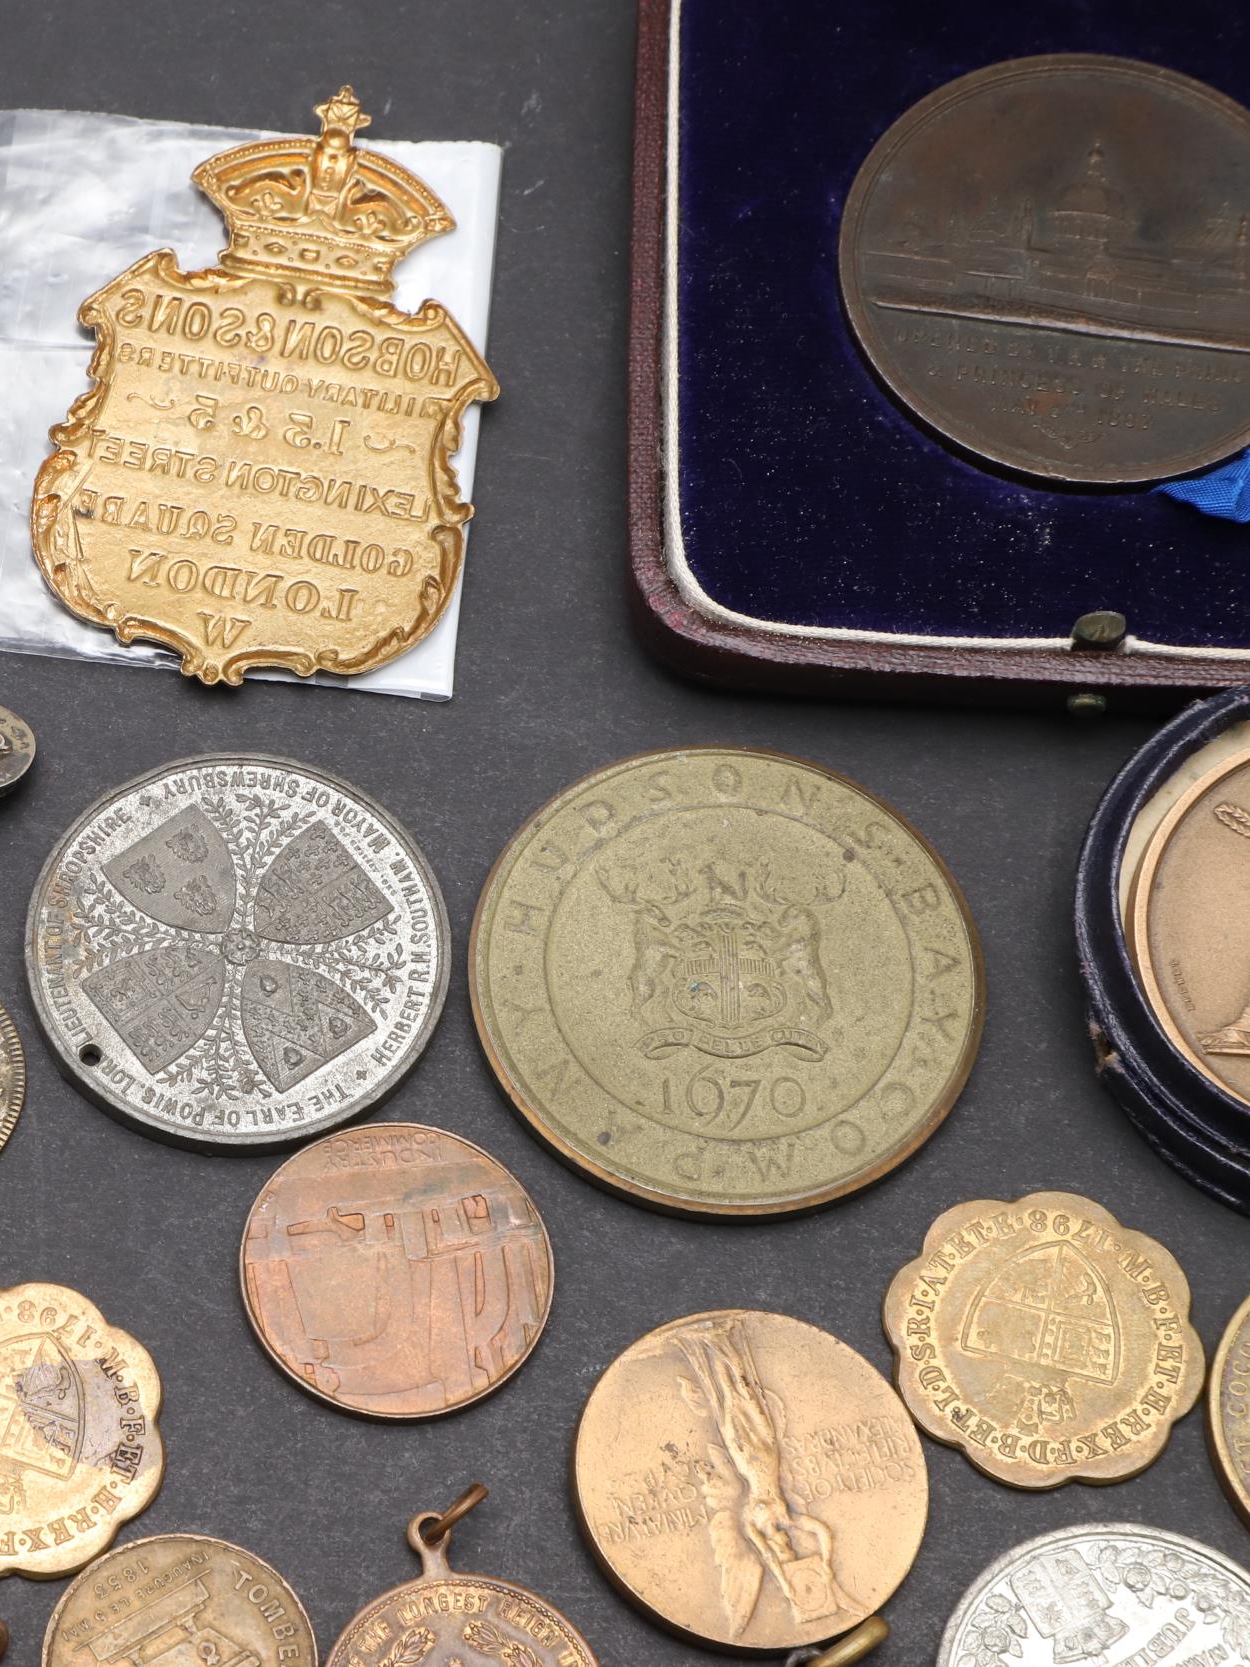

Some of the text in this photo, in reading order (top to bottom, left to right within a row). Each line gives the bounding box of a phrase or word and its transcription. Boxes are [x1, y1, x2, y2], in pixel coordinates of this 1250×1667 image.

[163, 769, 301, 799] SHREWSBURY
[302, 784, 330, 808] OF
[330, 801, 394, 854] MAYOR
[47, 807, 133, 908] SHROPSHIRE
[901, 881, 962, 1043] BAY
[47, 940, 91, 1050] LIEUTENANT
[372, 987, 431, 1067] HERBERT
[313, 1085, 347, 1112] THE
[212, 1110, 239, 1128] OF
[251, 1104, 306, 1128] EARL
[323, 1146, 445, 1171] INDUSTRY
[324, 1131, 443, 1155] COMMERCE
[834, 1458, 916, 1496] SOCIETY
[92, 1561, 150, 1601] 1853
[108, 1592, 132, 1616] LE
[230, 1567, 302, 1661] TOMBE
[60, 1618, 91, 1641] MAI
[357, 1591, 558, 1654] THE LONGEST REIGN
